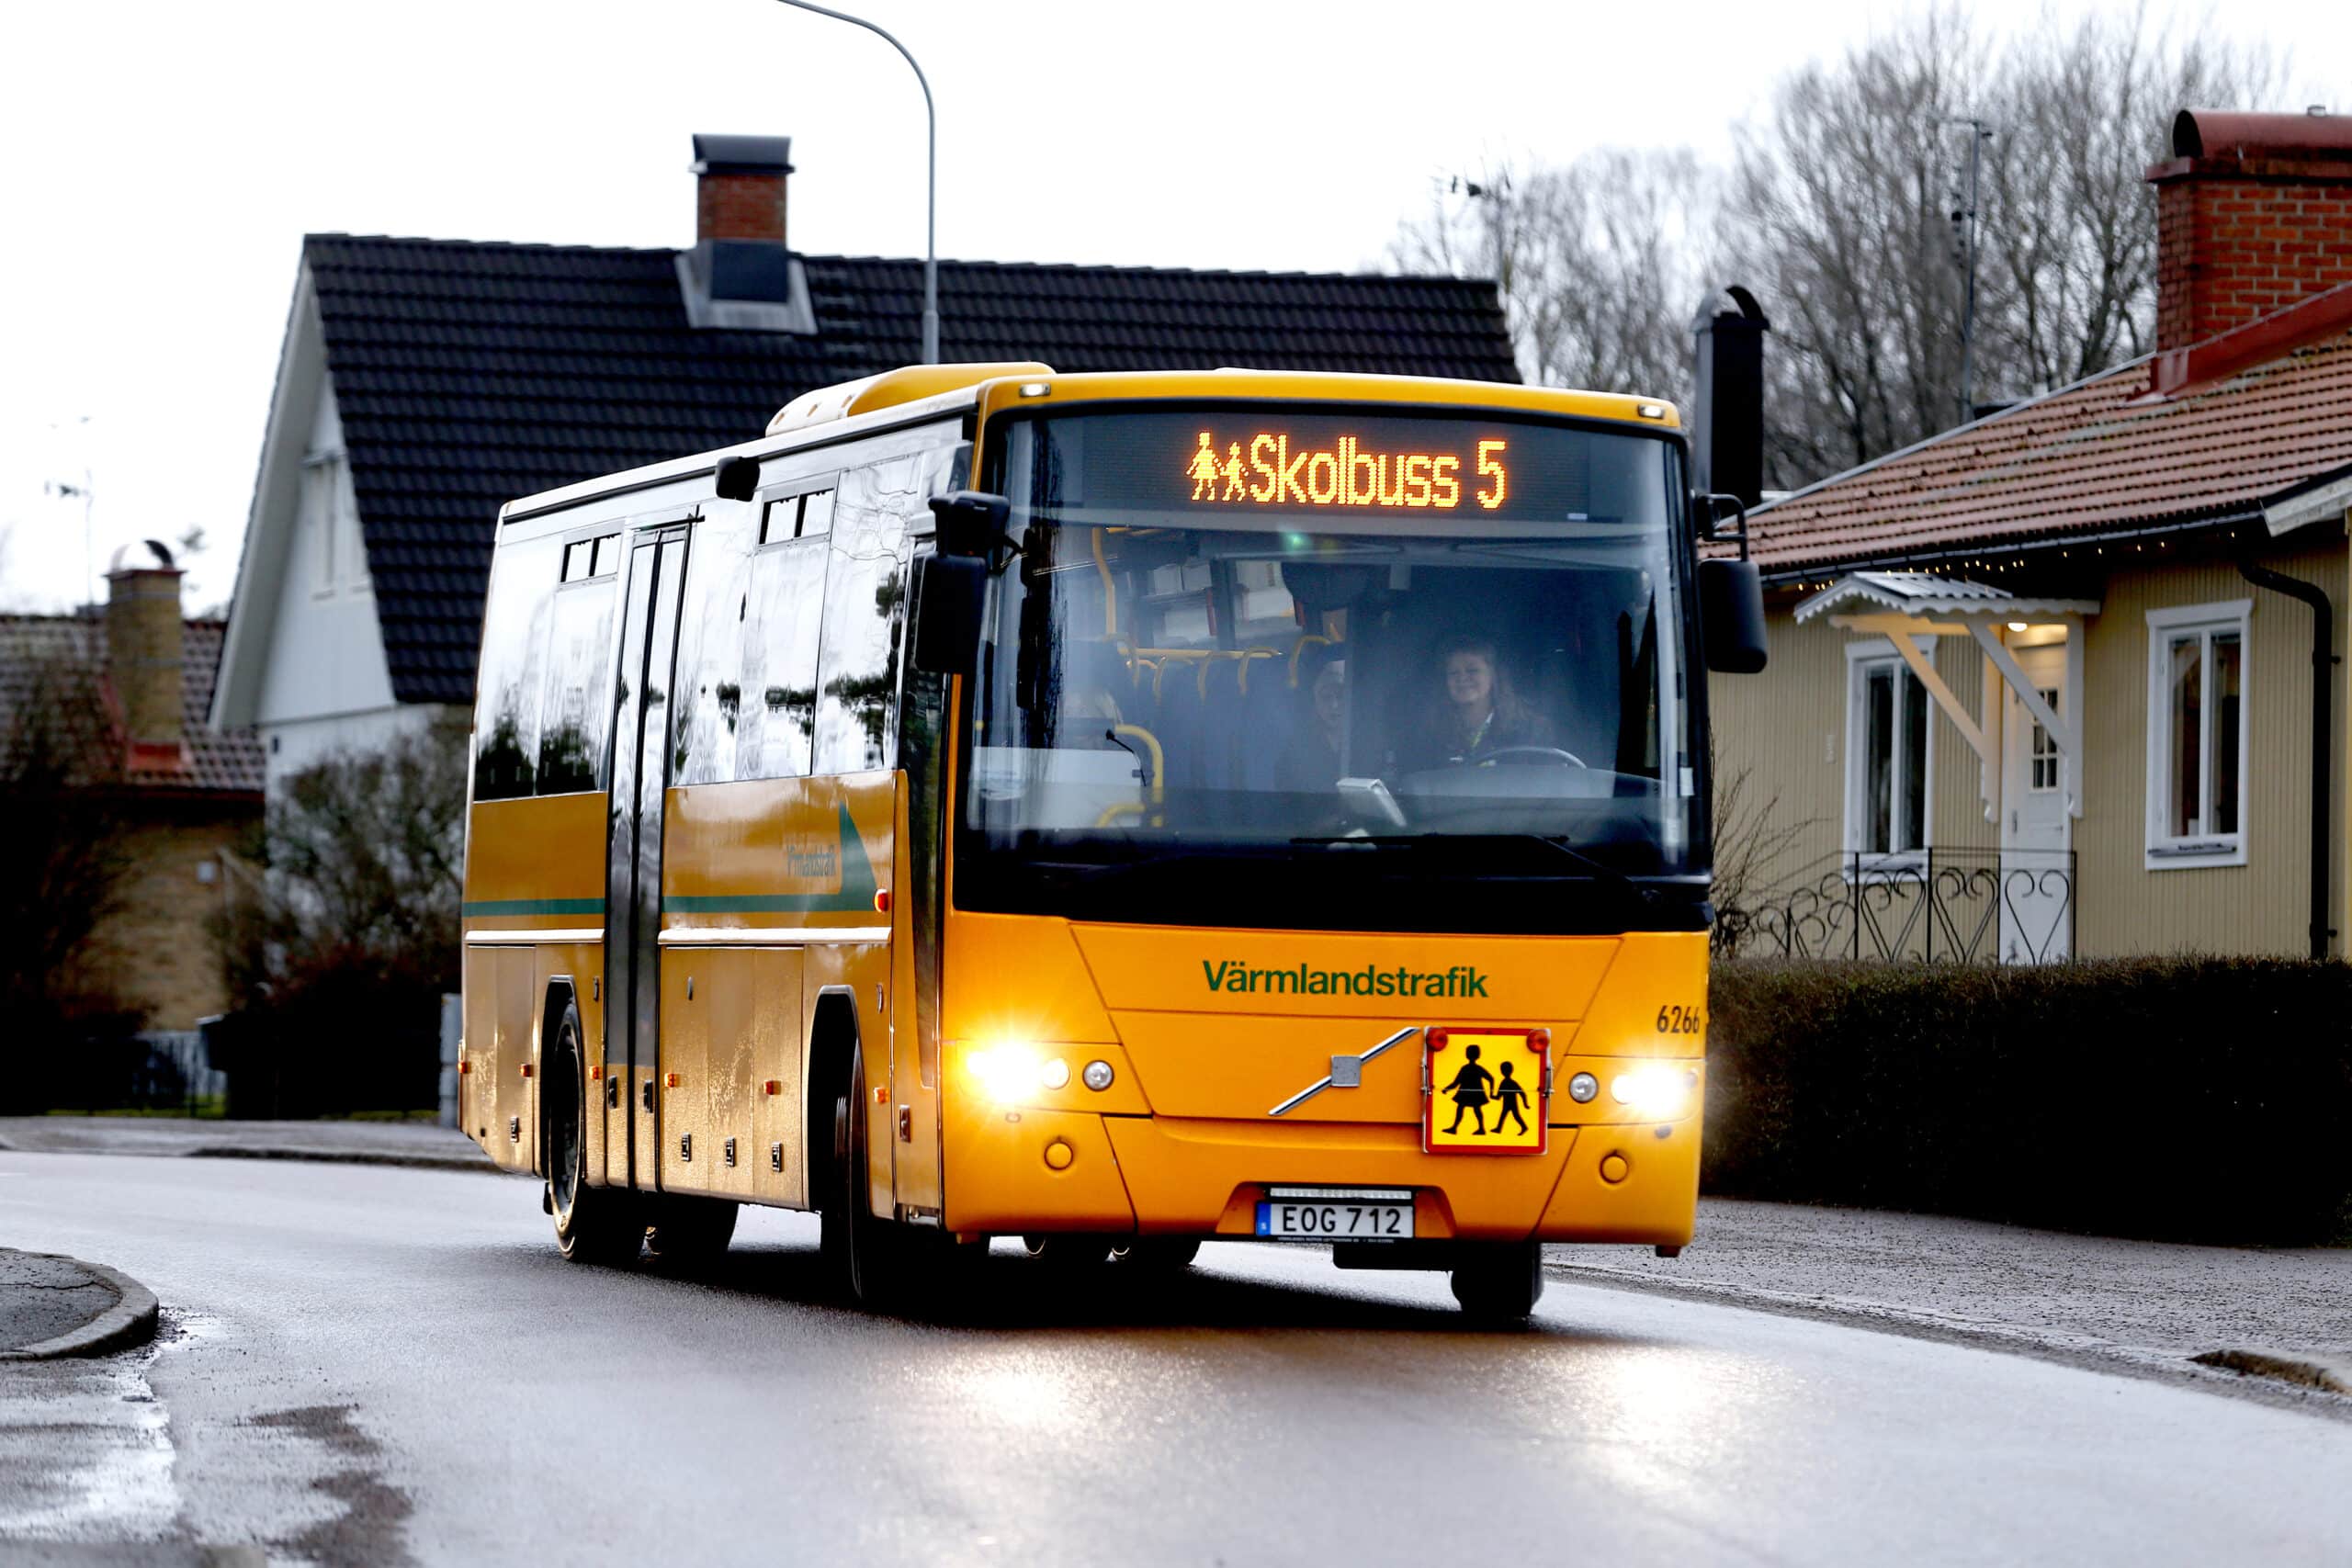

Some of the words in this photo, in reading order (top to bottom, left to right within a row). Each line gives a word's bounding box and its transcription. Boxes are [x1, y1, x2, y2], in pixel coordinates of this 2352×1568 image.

[1250, 433, 1460, 508] Skolbuss
[1477, 440, 1507, 509] 5
[1202, 960, 1488, 998] Värmlandstrafik
[1657, 1005, 1700, 1033] 6266
[1283, 1206, 1336, 1233] EOG
[1346, 1208, 1400, 1234] 712
